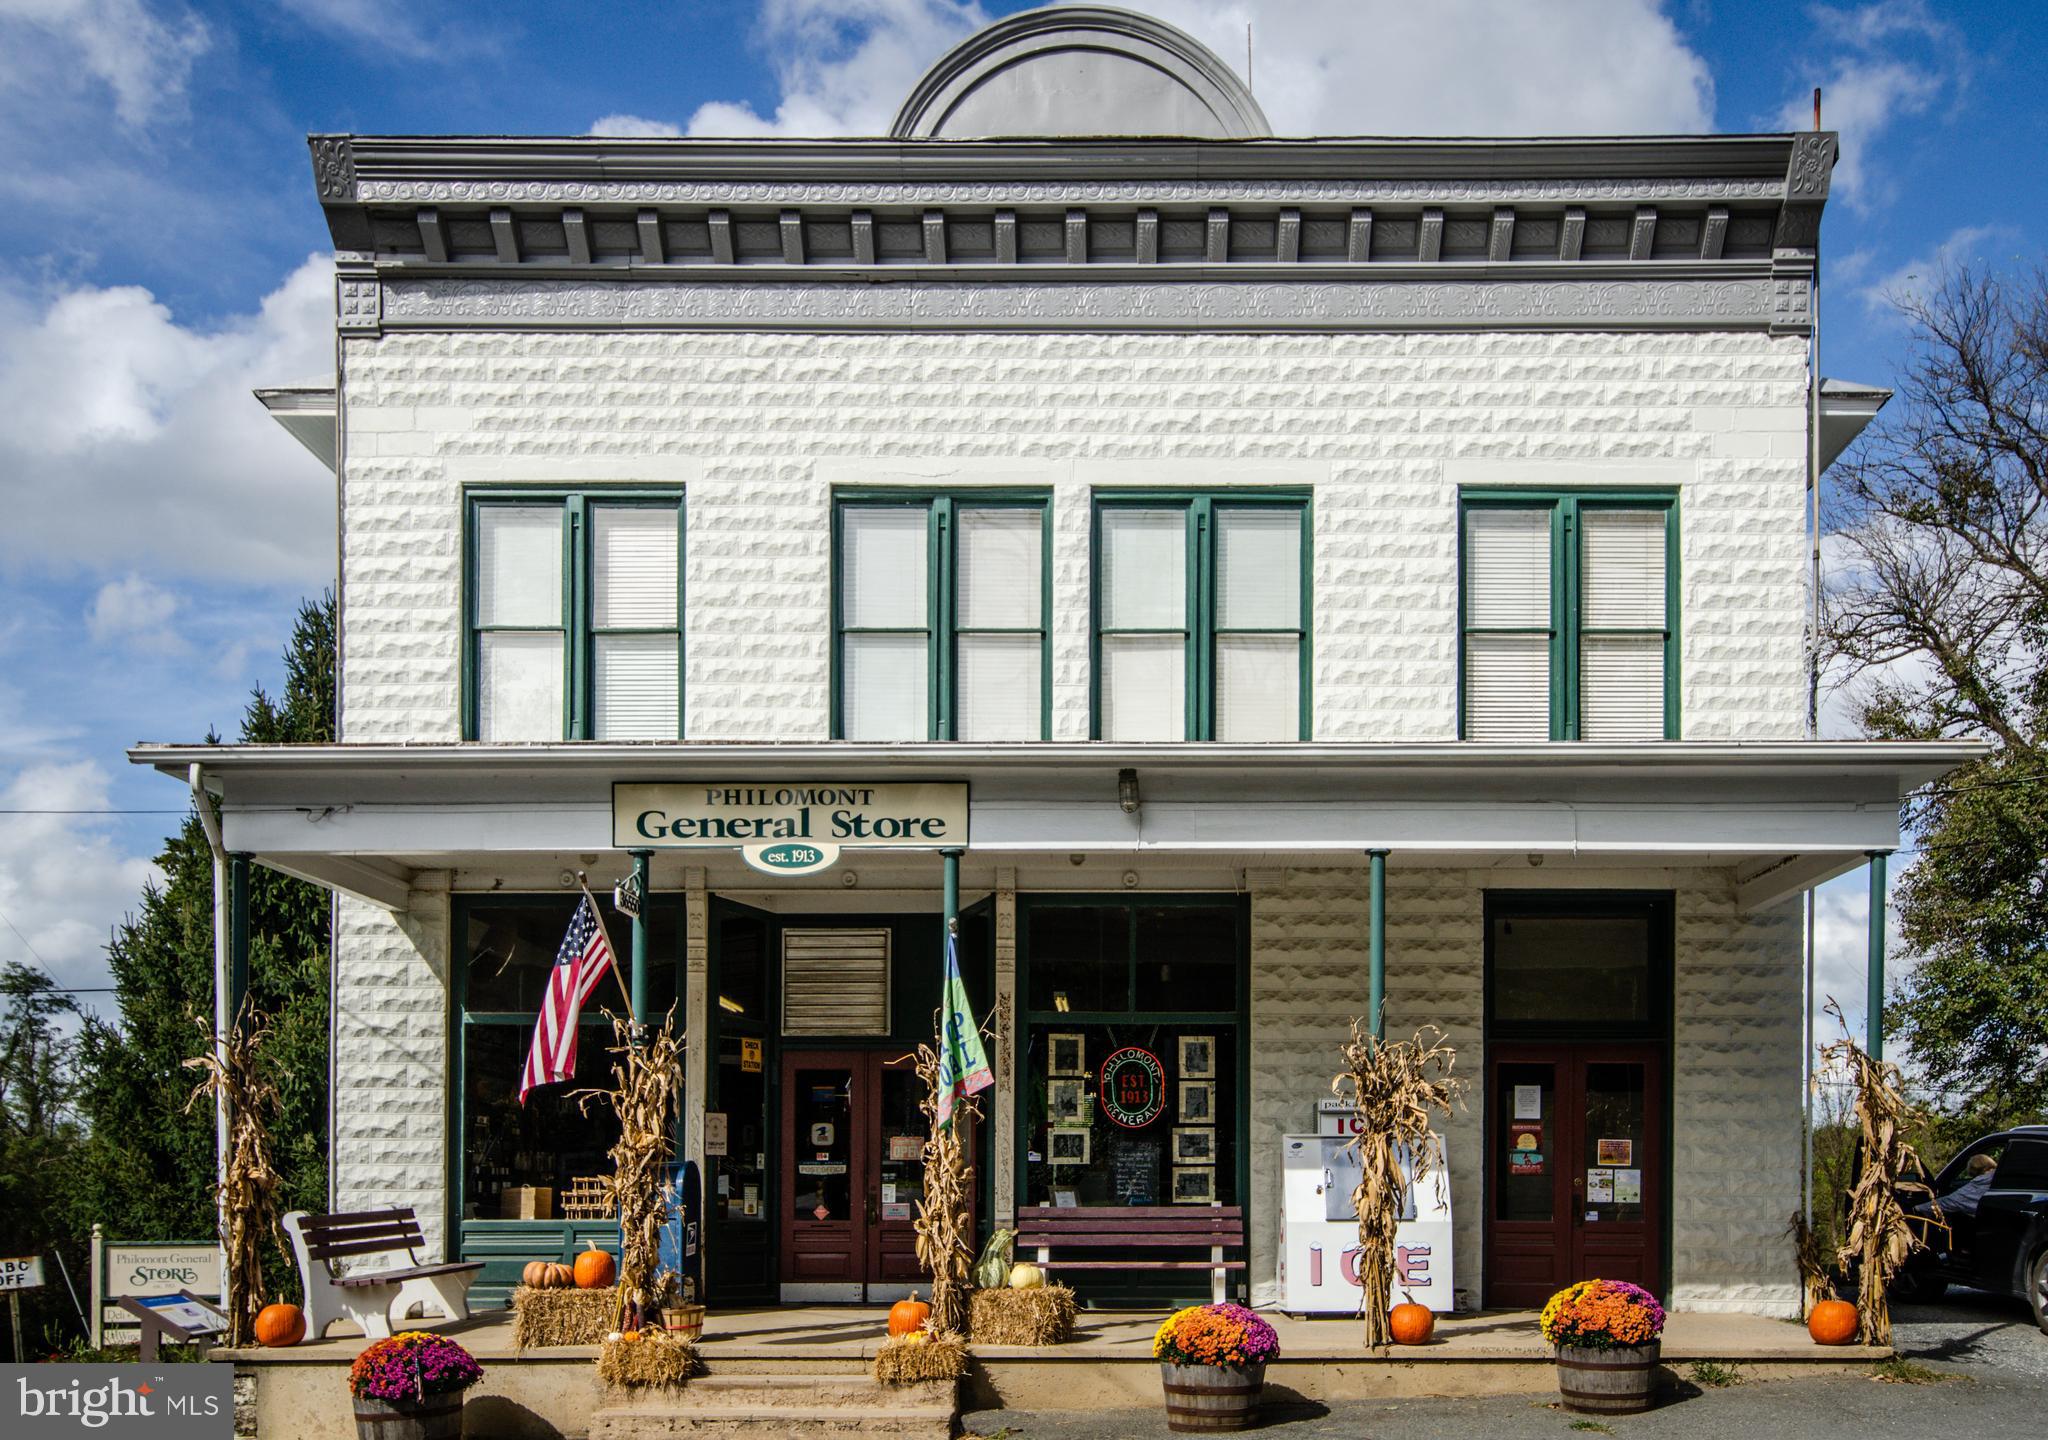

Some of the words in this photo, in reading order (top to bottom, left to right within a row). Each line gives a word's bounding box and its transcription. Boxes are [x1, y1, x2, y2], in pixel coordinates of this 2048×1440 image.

[706, 789, 875, 806] PHILOMONT
[636, 808, 814, 838] General
[831, 809, 947, 838] Store
[767, 851, 790, 863] est.
[792, 849, 816, 864] 1913
[744, 1040, 760, 1050] CHECK
[743, 1059, 761, 1069] STATION
[1104, 1050, 1161, 1084] PHILOMONT
[1120, 1089, 1150, 1104] 1913
[1324, 1099, 1360, 1109] packa
[1107, 1105, 1160, 1126] GENERAL
[1337, 1118, 1366, 1134] IC
[116, 1254, 170, 1265] Philomont
[170, 1253, 212, 1264] General
[1309, 1240, 1432, 1287] ICE
[130, 1266, 199, 1286] STORE
[107, 1310, 125, 1320] Deli
